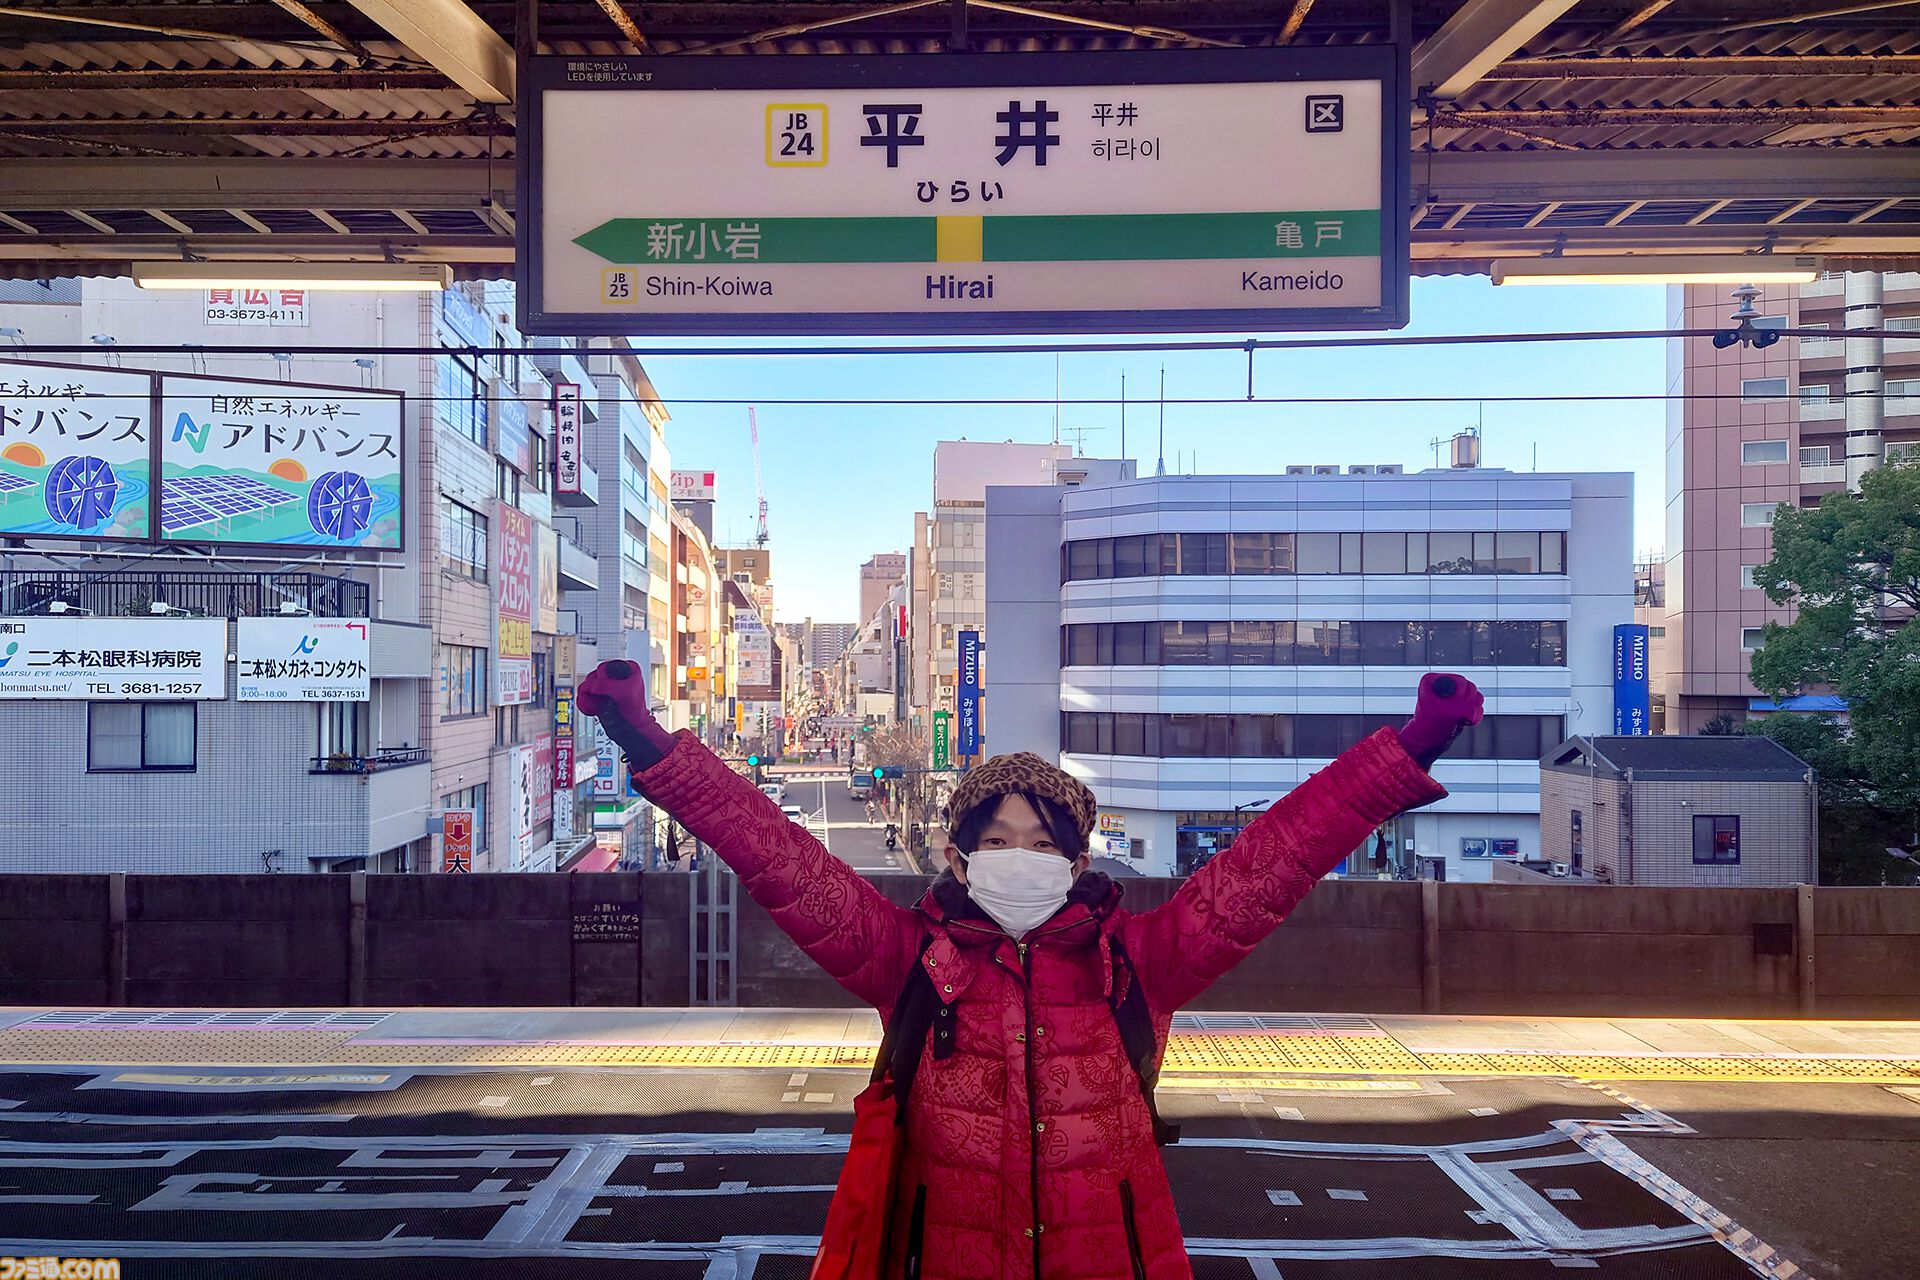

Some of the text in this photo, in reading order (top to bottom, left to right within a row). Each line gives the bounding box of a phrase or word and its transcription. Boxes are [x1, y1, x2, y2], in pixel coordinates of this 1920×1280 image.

[567, 73, 653, 82] LEDを使用しています
[786, 113, 808, 130] JB
[1091, 102, 1139, 127] 平井
[780, 133, 815, 156] 24
[1091, 137, 1161, 161] 히라이
[917, 181, 1004, 203] ひらい
[646, 222, 761, 260] 新小岩
[1274, 219, 1344, 249] 亀戸
[612, 273, 626, 284] JB
[646, 276, 773, 297] Shin-Koiwa
[925, 275, 994, 299] Hirai
[1242, 271, 1344, 291] Kameido
[609, 285, 629, 298] 25
[207, 309, 304, 320] 03-3673-4111
[211, 394, 361, 421] 自然エネルギー
[222, 423, 397, 459] アドバンス
[500, 571, 530, 613] スロット
[0, 623, 26, 634] 南口
[27, 650, 201, 668] 二本松眼科病院
[965, 639, 975, 684] MIZUHO
[1633, 635, 1644, 680] MIZUHO
[240, 659, 367, 679] 二本松メガネ・コンタクト
[86, 683, 115, 694] TEL
[121, 683, 202, 694] 3681-1257
[302, 690, 365, 698] TEL 3637-1531
